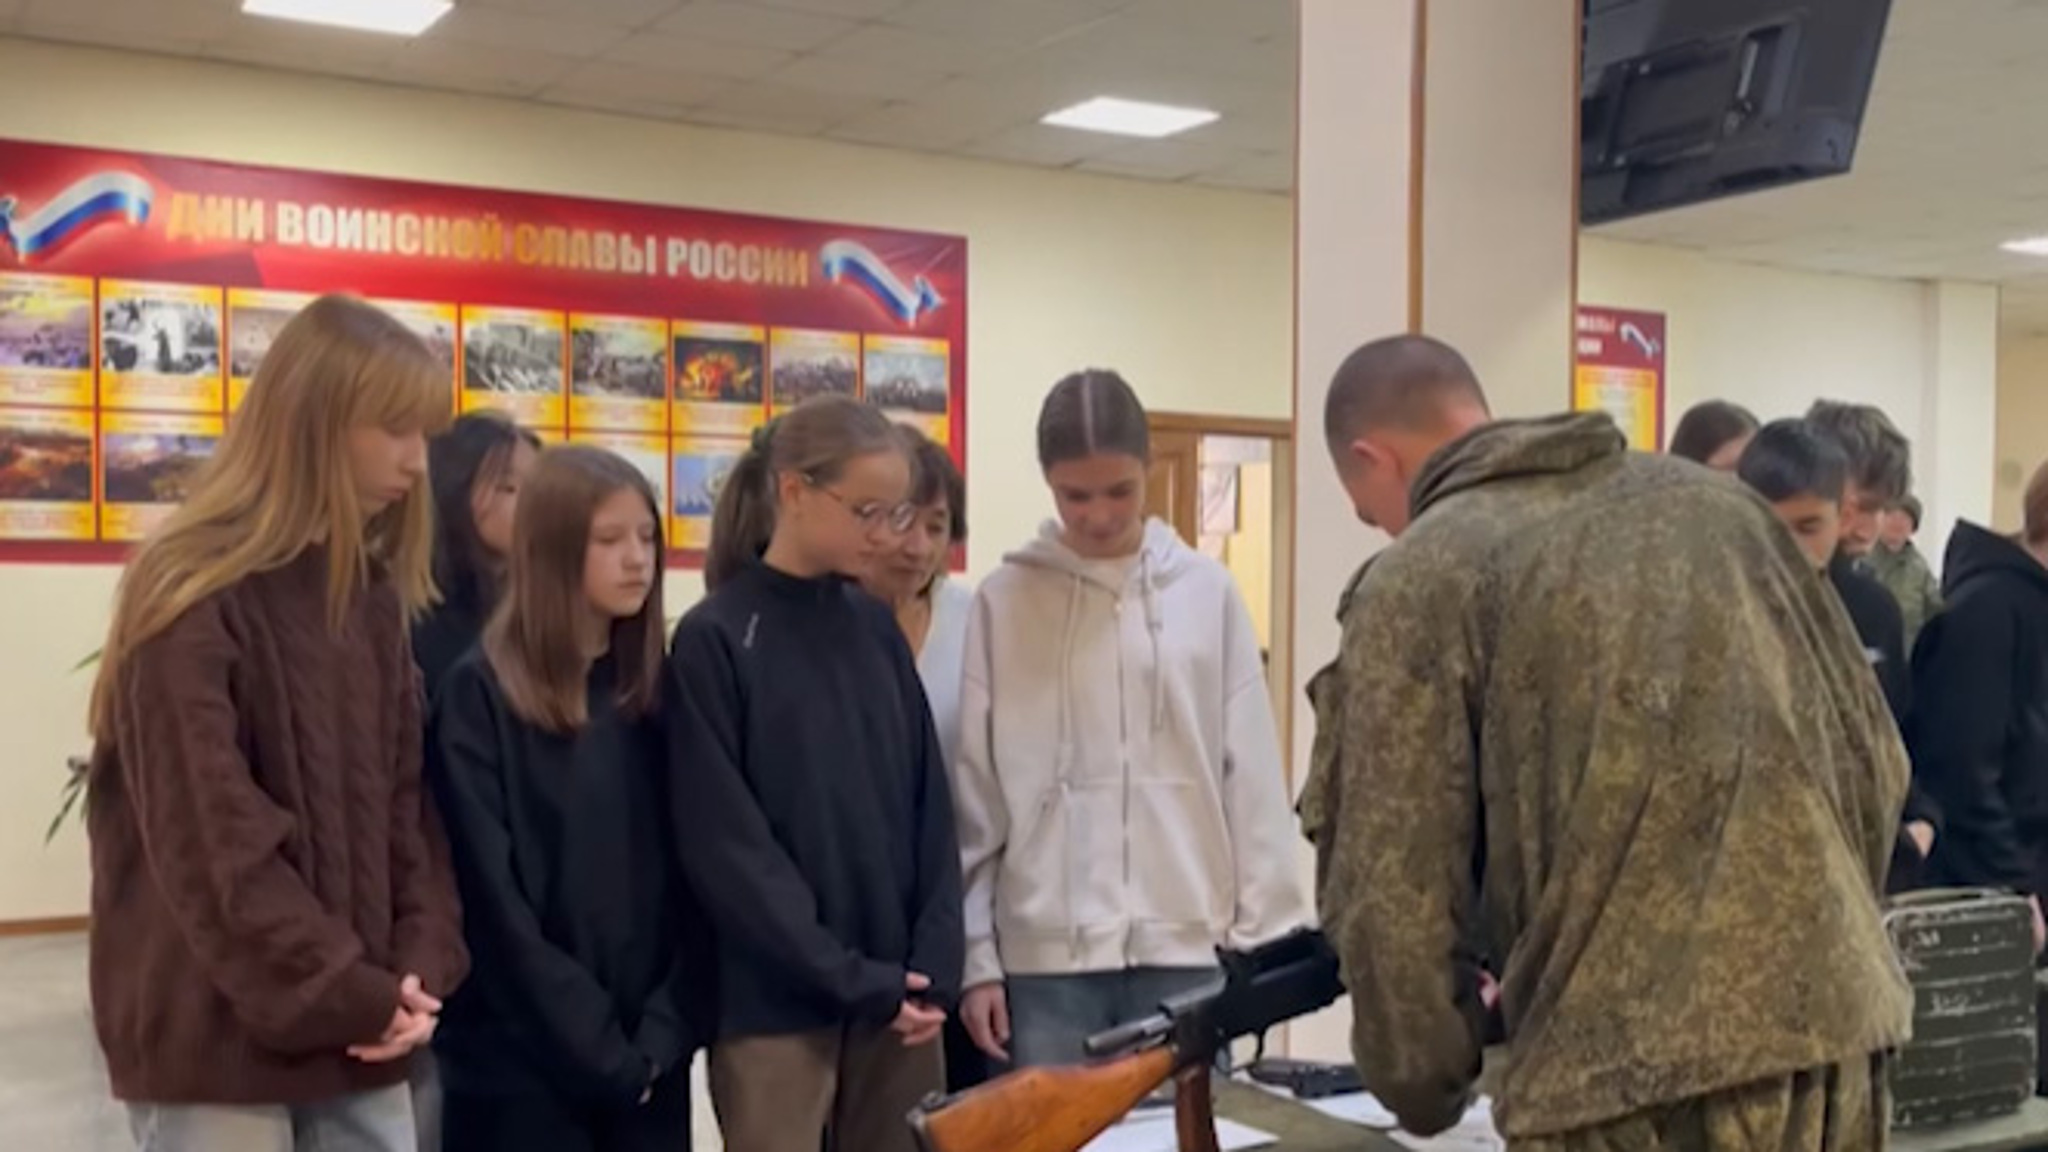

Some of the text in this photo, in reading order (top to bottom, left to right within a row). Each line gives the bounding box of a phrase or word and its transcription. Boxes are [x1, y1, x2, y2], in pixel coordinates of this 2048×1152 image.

[166, 192, 809, 289] ДНИ ВОИНСКОЙ СЛАВЫ РОССИИ
